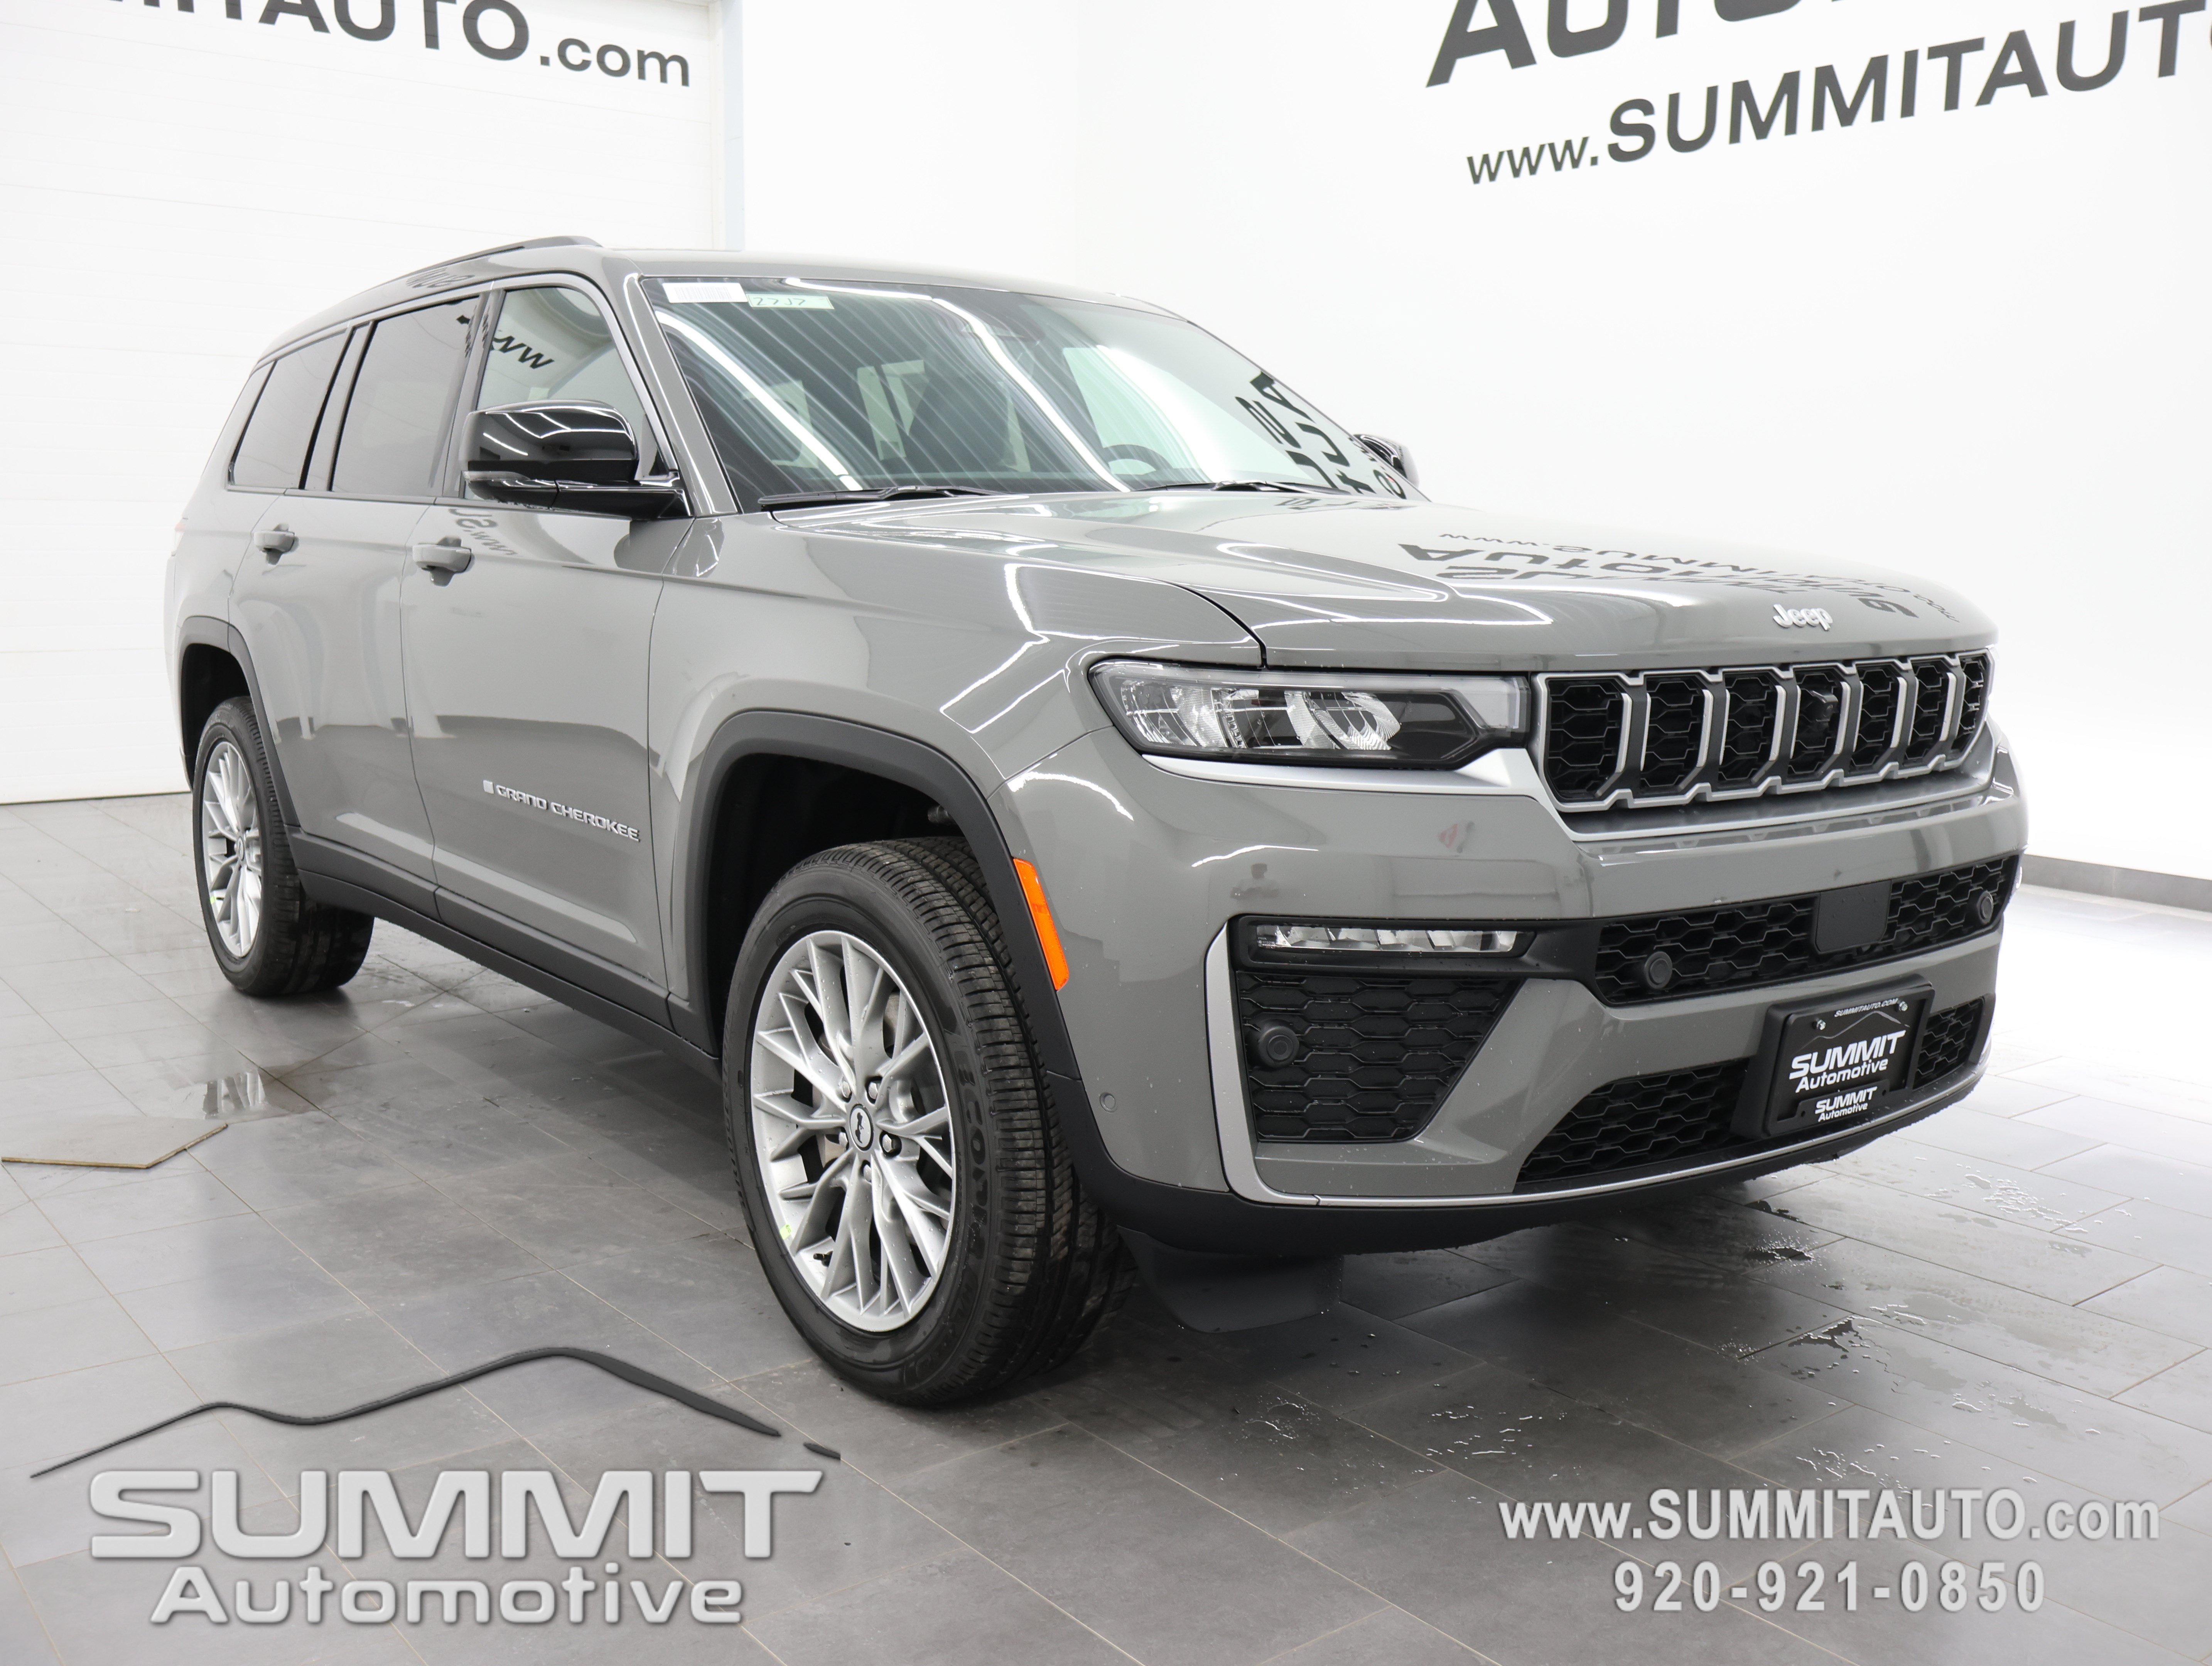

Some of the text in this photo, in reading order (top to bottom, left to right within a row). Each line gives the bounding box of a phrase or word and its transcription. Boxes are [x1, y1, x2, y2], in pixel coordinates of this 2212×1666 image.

[1466, 0, 2212, 185] www.SUMMITAUT
[1773, 604, 1833, 631] Jeep
[496, 785, 640, 842] GRAND CHEROKEE
[1834, 998, 1898, 1017] SUMMITAUTO.COM
[1789, 1030, 1906, 1079] SUMMIT
[1795, 1057, 1888, 1093] Automotive
[1815, 1086, 1877, 1114] SUMMIT
[1818, 1102, 1868, 1122] Automotive
[954, 1051, 988, 1259] ECOPIA
